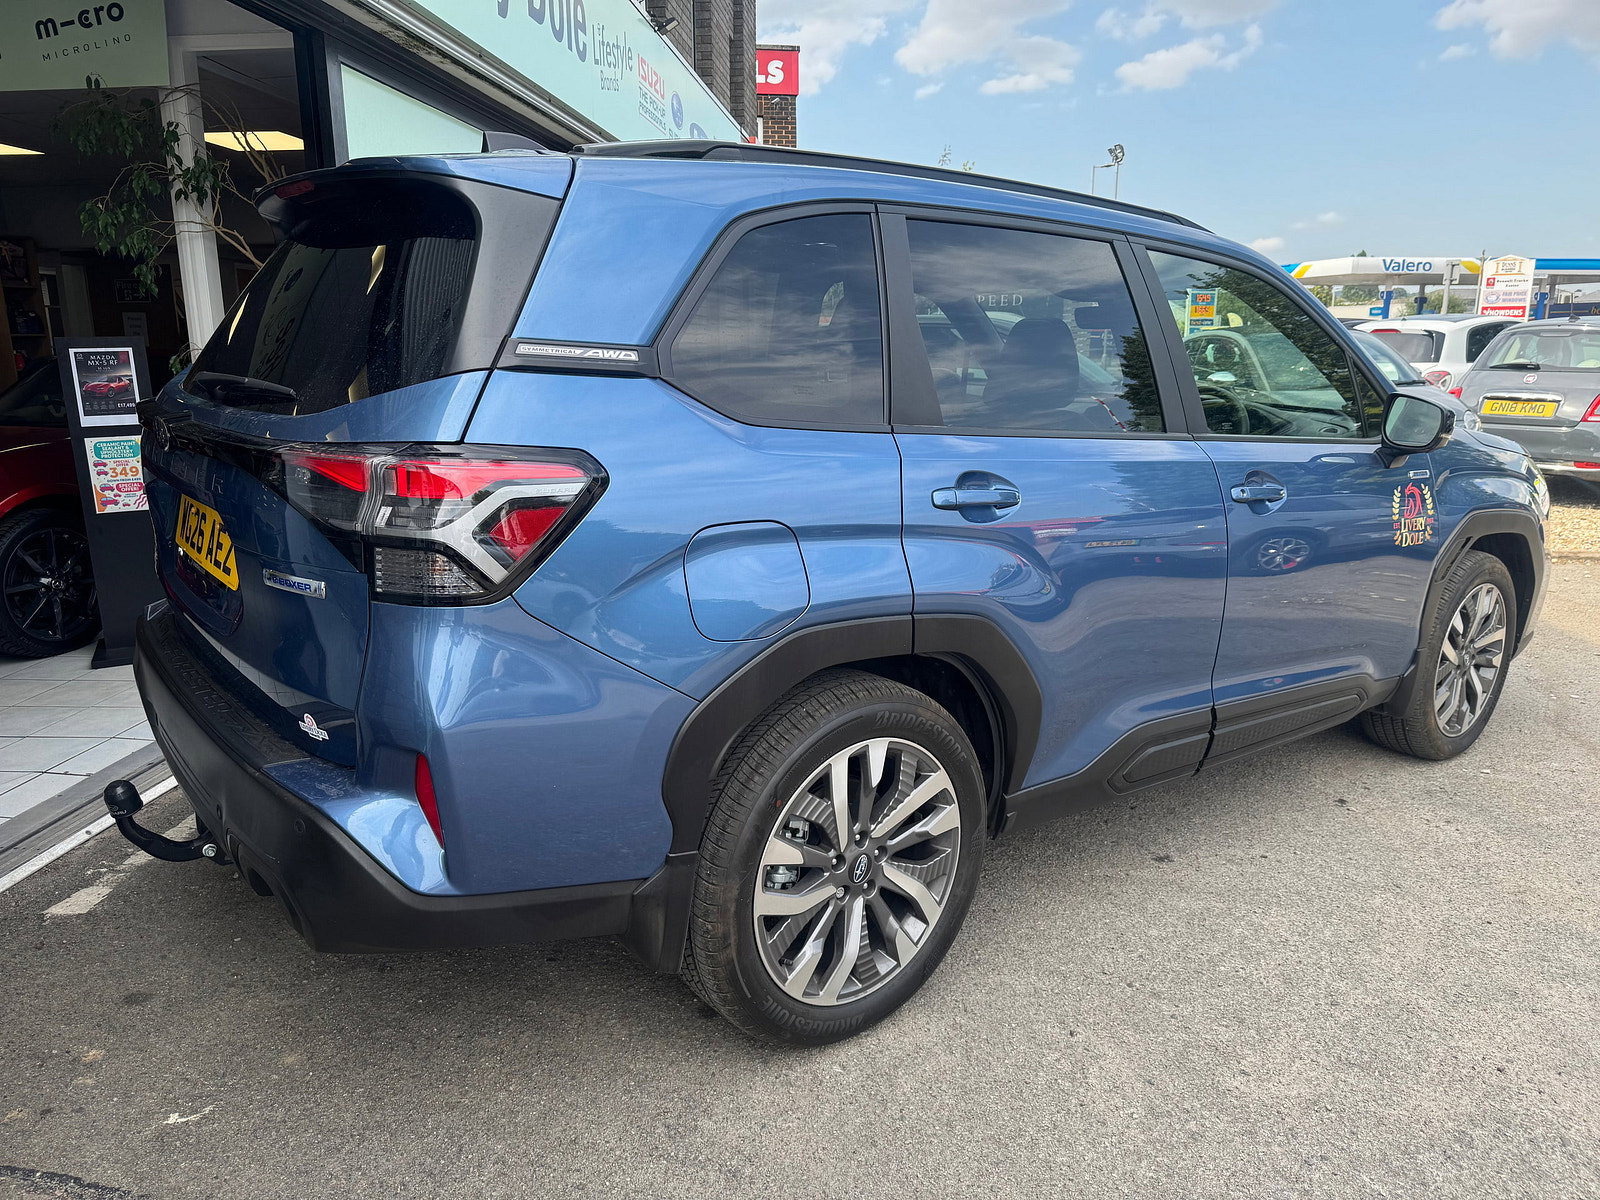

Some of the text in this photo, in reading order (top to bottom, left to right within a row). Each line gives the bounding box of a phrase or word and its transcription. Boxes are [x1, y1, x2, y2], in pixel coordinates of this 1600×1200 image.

[528, 0, 587, 63] ole
[42, 33, 131, 62] MICROLINO
[592, 22, 633, 80] Lifestyle
[600, 70, 619, 92] Brands
[637, 53, 665, 100] ISUZU
[1382, 259, 1432, 272] Valero
[522, 346, 637, 360] SYMMETRICAL AWD
[109, 466, 139, 478] 349
[1401, 516, 1426, 533] LIVERY
[1402, 532, 1424, 547] DOLE
